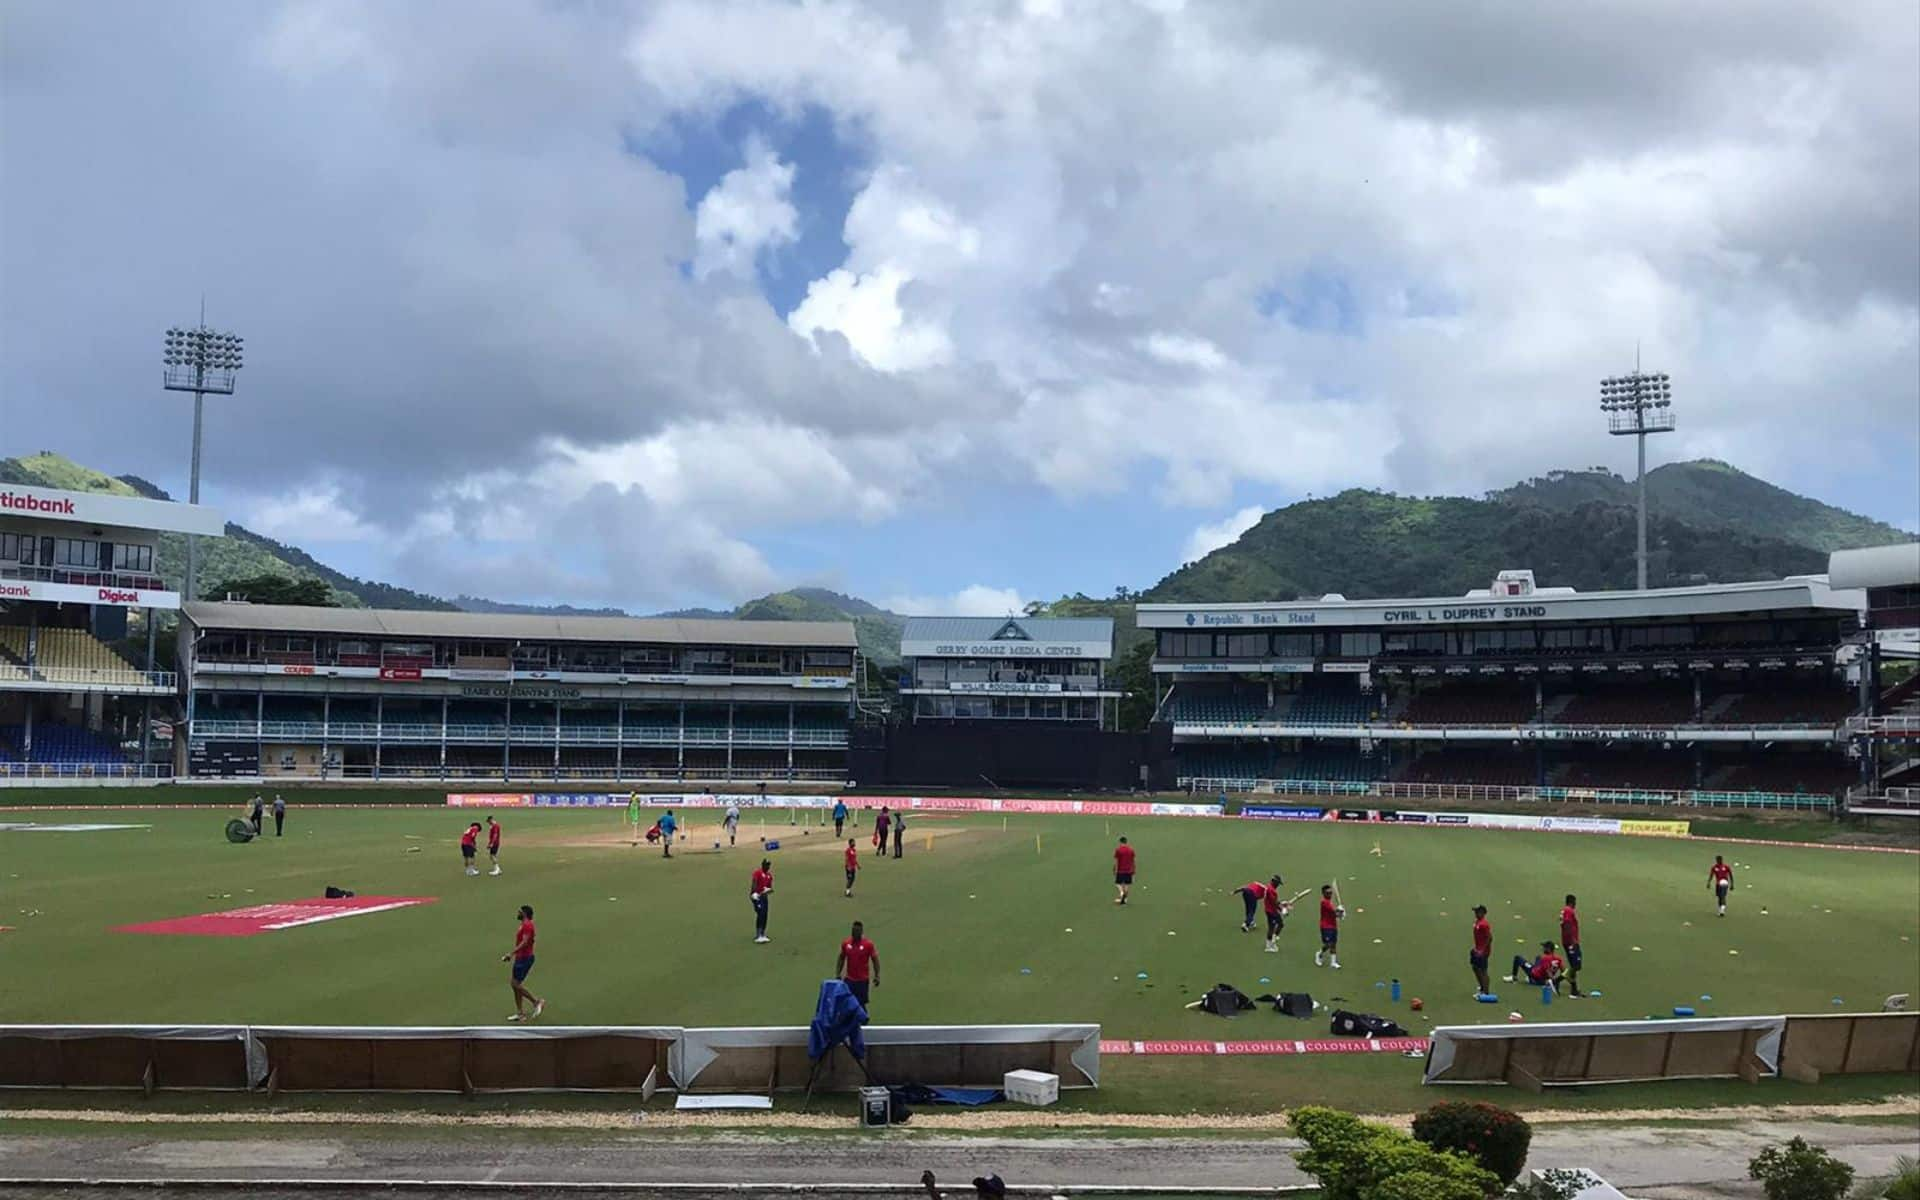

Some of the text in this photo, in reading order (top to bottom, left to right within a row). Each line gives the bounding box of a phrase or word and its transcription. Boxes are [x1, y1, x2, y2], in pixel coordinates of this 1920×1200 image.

[99, 589, 139, 603] Digicel
[1203, 613, 1316, 626] Republic Bank Stand
[1384, 606, 1547, 622] CYRIL L DUPREY STAND
[936, 644, 1083, 656] GERRY GOMEZ MEDIA CENTRE
[553, 687, 580, 698] STAND
[1145, 1041, 1210, 1052] COLONIAL
[1227, 1041, 1290, 1052] COLONIAL
[1305, 1040, 1368, 1051] COLONIAL
